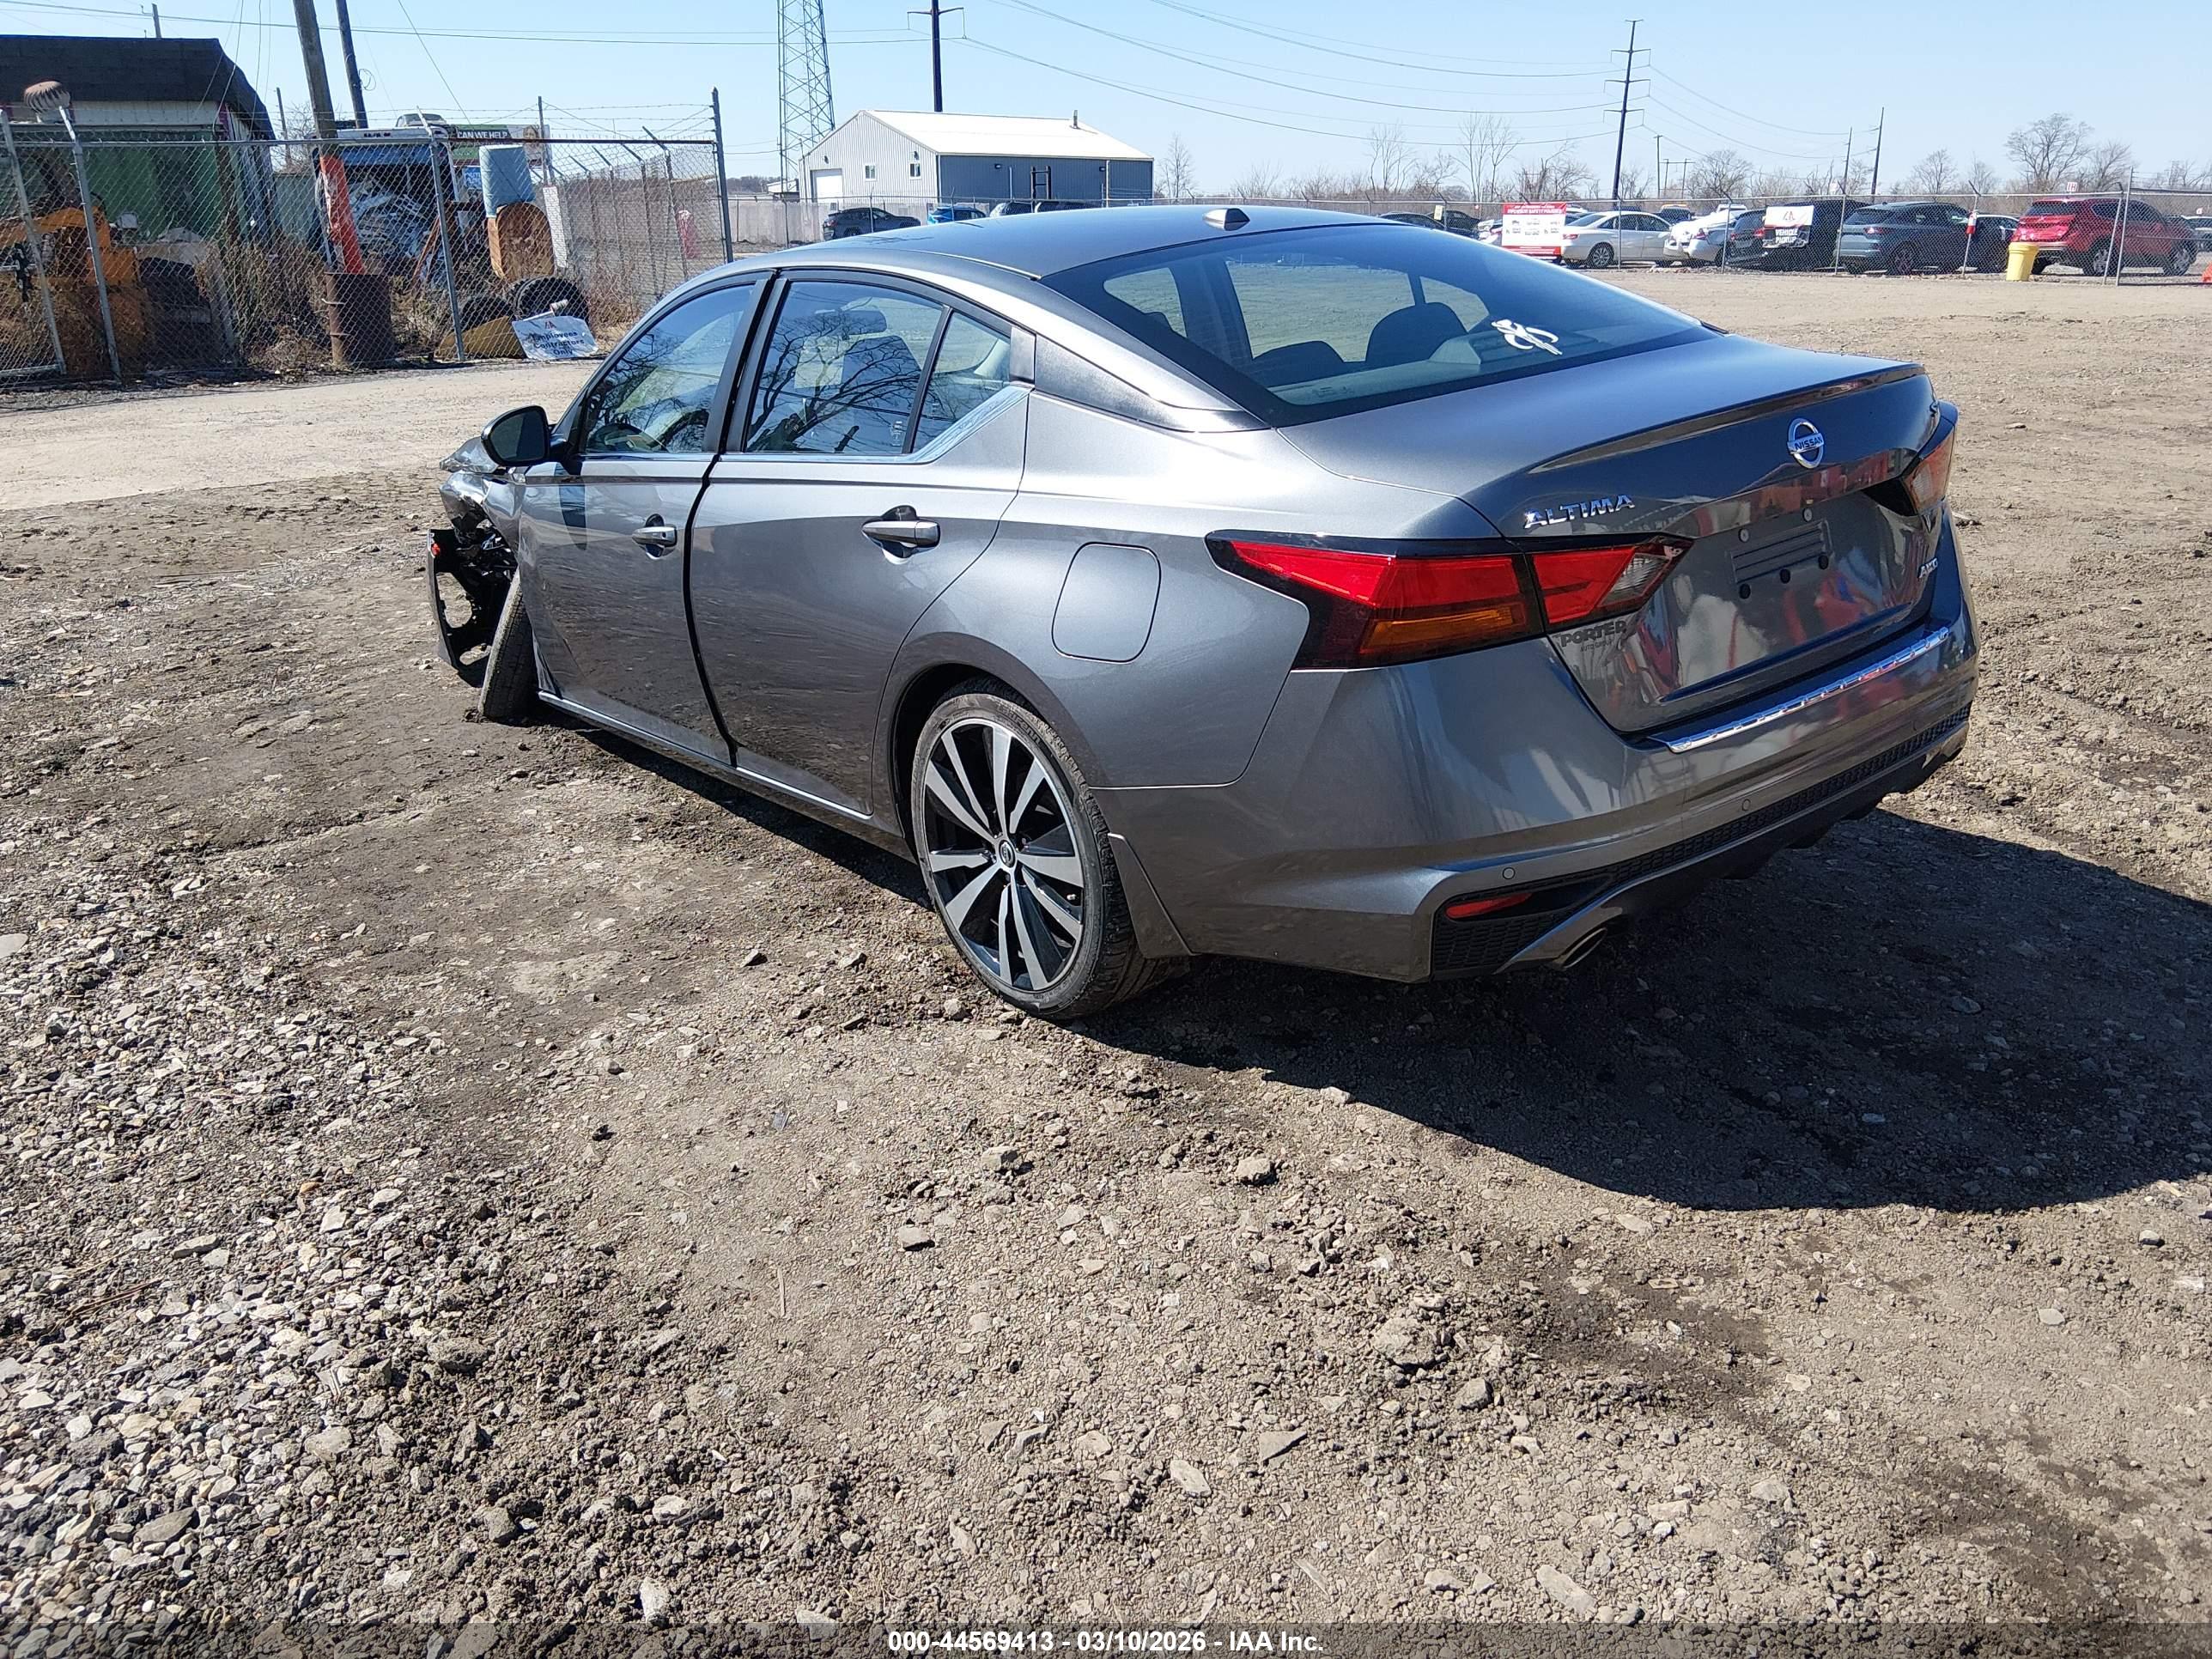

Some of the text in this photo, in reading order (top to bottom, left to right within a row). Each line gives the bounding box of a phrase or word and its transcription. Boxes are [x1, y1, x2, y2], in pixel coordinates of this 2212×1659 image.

[532, 331, 578, 342] Employees
[533, 338, 585, 349] Contractors
[552, 347, 574, 356] Only
[1795, 436, 1823, 451] NISSAN
[1523, 495, 1636, 529] ALTIMA
